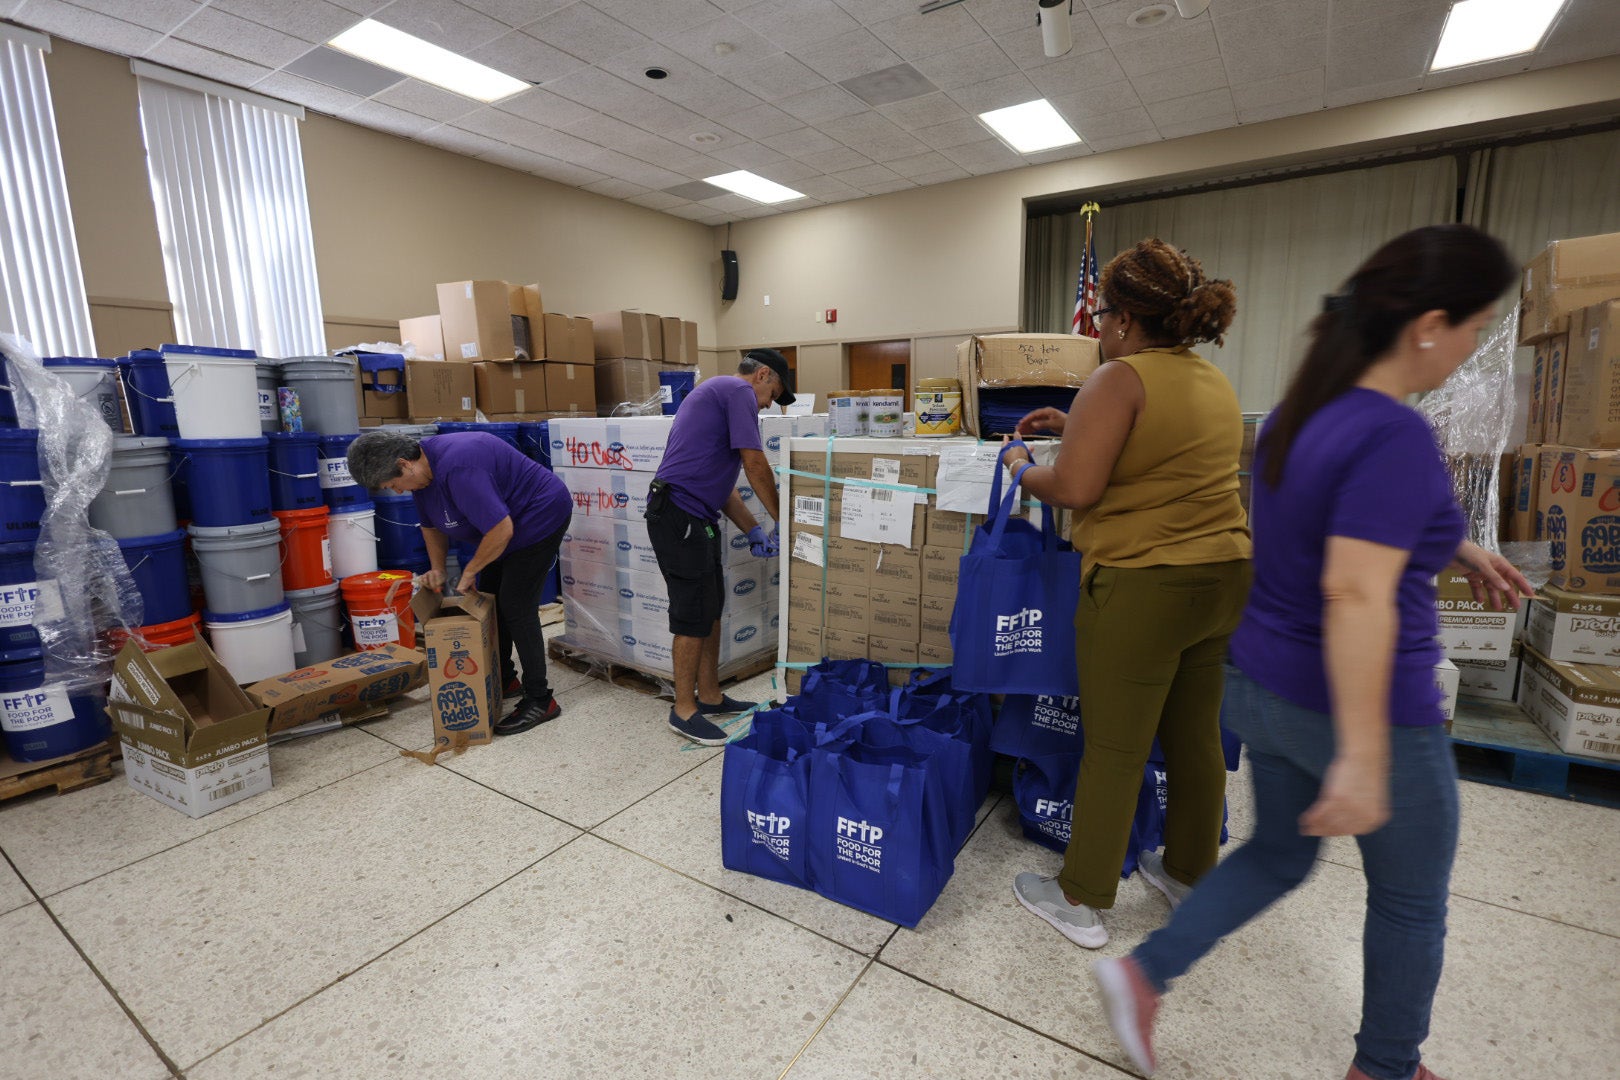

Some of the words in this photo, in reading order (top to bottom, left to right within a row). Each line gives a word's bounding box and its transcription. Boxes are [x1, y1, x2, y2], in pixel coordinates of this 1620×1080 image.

[566, 437, 589, 466] 40
[1581, 525, 1620, 548] aby
[0, 605, 21, 614] OOD
[1456, 600, 1485, 611] PACK
[1572, 603, 1602, 612] 4x24
[1440, 615, 1474, 624] PREMIUM
[1474, 616, 1506, 625] DIAPERS
[995, 632, 1020, 643] FOOD
[1022, 630, 1042, 638] FOR
[995, 643, 1013, 651] THE
[1014, 639, 1042, 648] POOR
[437, 687, 477, 712] baby
[8, 711, 31, 719] FOOD
[32, 706, 52, 715] FOR
[27, 712, 54, 722] POOR
[441, 704, 480, 725] happy
[1035, 705, 1060, 718] FOOD
[1061, 712, 1079, 722] FOR
[1577, 711, 1613, 724] predo
[1033, 713, 1051, 723] THE
[1052, 718, 1078, 731] POOR
[216, 743, 241, 756] JUMBO
[241, 736, 259, 747] PACK
[837, 836, 861, 852] FOOD
[862, 845, 881, 859] FOR
[837, 845, 853, 857] THE
[855, 852, 881, 868] POOR
